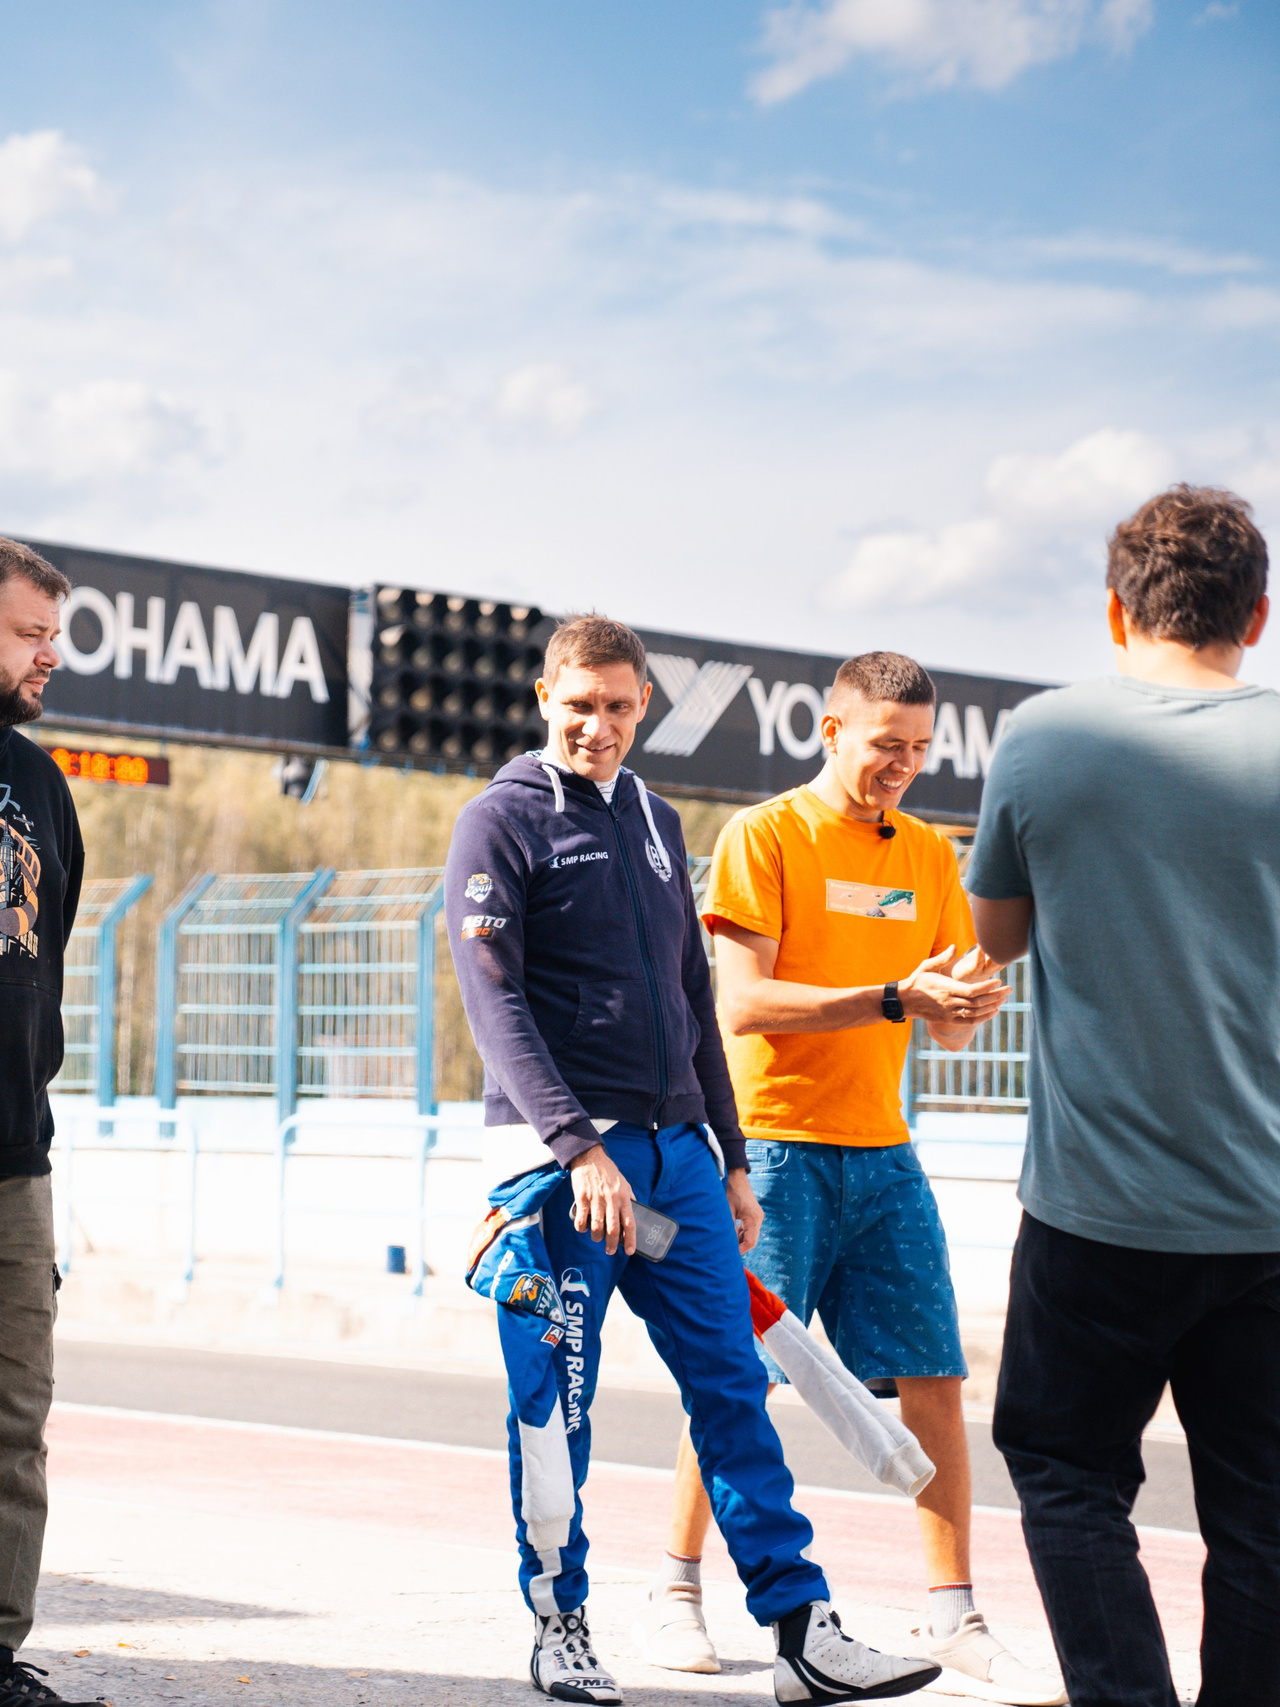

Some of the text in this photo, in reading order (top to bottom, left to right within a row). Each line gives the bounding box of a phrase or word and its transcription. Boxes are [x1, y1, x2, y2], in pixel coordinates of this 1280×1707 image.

[561, 852, 609, 866] SMP RACING
[645, 1224, 662, 1246] 13:53
[565, 1300, 584, 1435] SMP RACING
